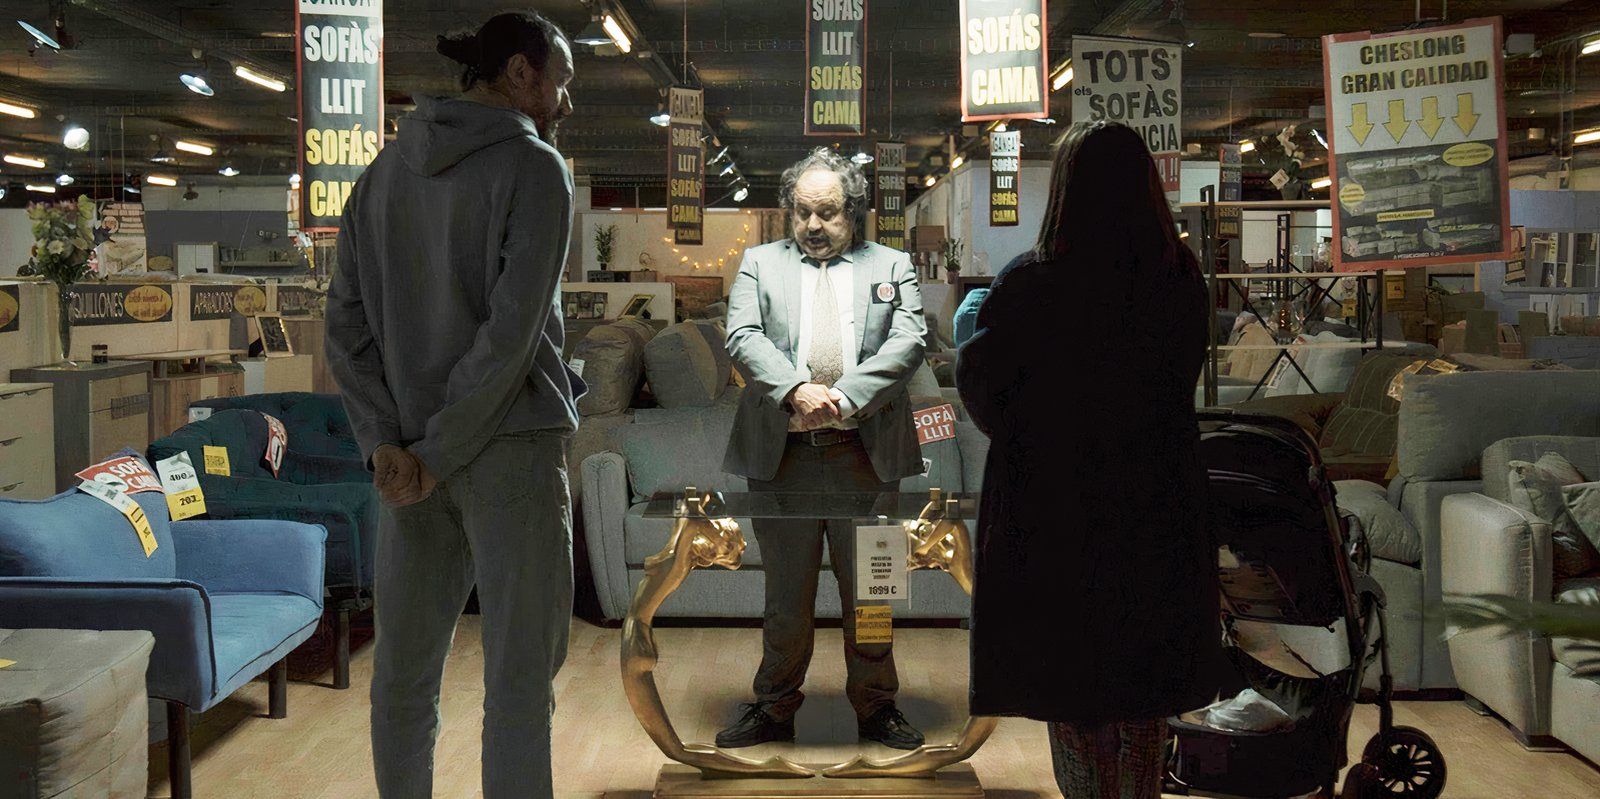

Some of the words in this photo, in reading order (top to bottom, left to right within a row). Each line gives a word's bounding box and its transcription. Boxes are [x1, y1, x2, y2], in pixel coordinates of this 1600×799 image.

[304, 21, 379, 64] SOFÀS
[822, 31, 854, 55] LLIT
[968, 8, 1041, 55] SOFÁS
[1360, 34, 1466, 65] CHESLONG
[811, 62, 863, 90] SOFÁS
[972, 66, 1040, 106] CAMA
[1341, 69, 1396, 94] GRAN
[1400, 60, 1488, 88] CALIDAD
[320, 77, 367, 115] LLIT
[1074, 85, 1093, 97] els
[1089, 83, 1179, 121] SOFÀS
[813, 101, 861, 125] CAMA
[305, 123, 378, 166] SOFÁS
[678, 154, 697, 173] LLIT
[997, 175, 1014, 189] LLIT
[884, 196, 901, 210] LLIT
[992, 209, 1017, 222] CAMA
[923, 423, 950, 440] LLIT
